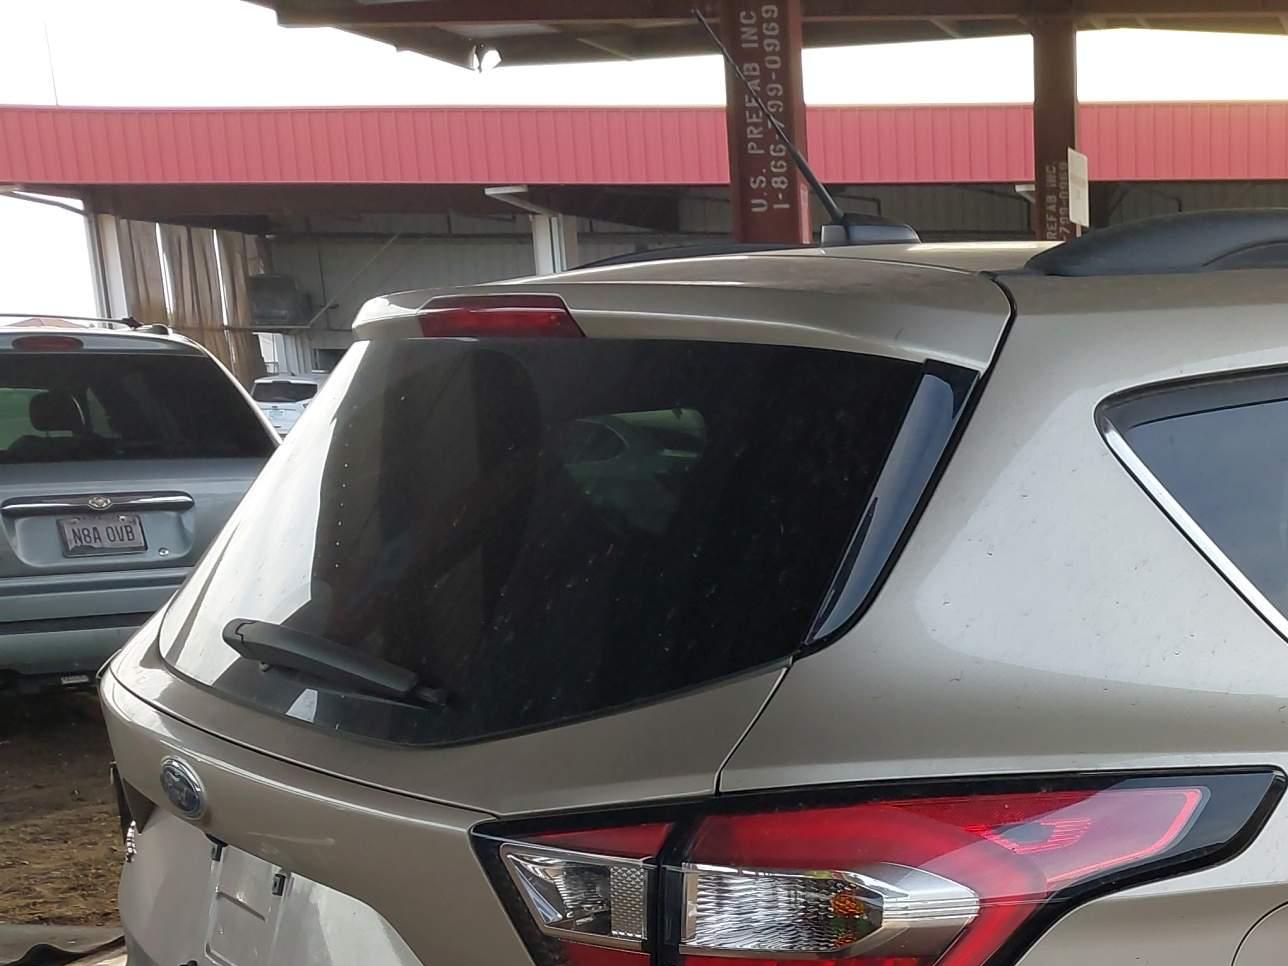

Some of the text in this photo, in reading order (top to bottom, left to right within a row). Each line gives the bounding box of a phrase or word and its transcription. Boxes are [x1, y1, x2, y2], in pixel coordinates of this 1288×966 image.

[743, 62, 765, 155] PREFAB
[761, 4, 791, 210] 1-866-799-0969
[1046, 193, 1057, 241] REFAB
